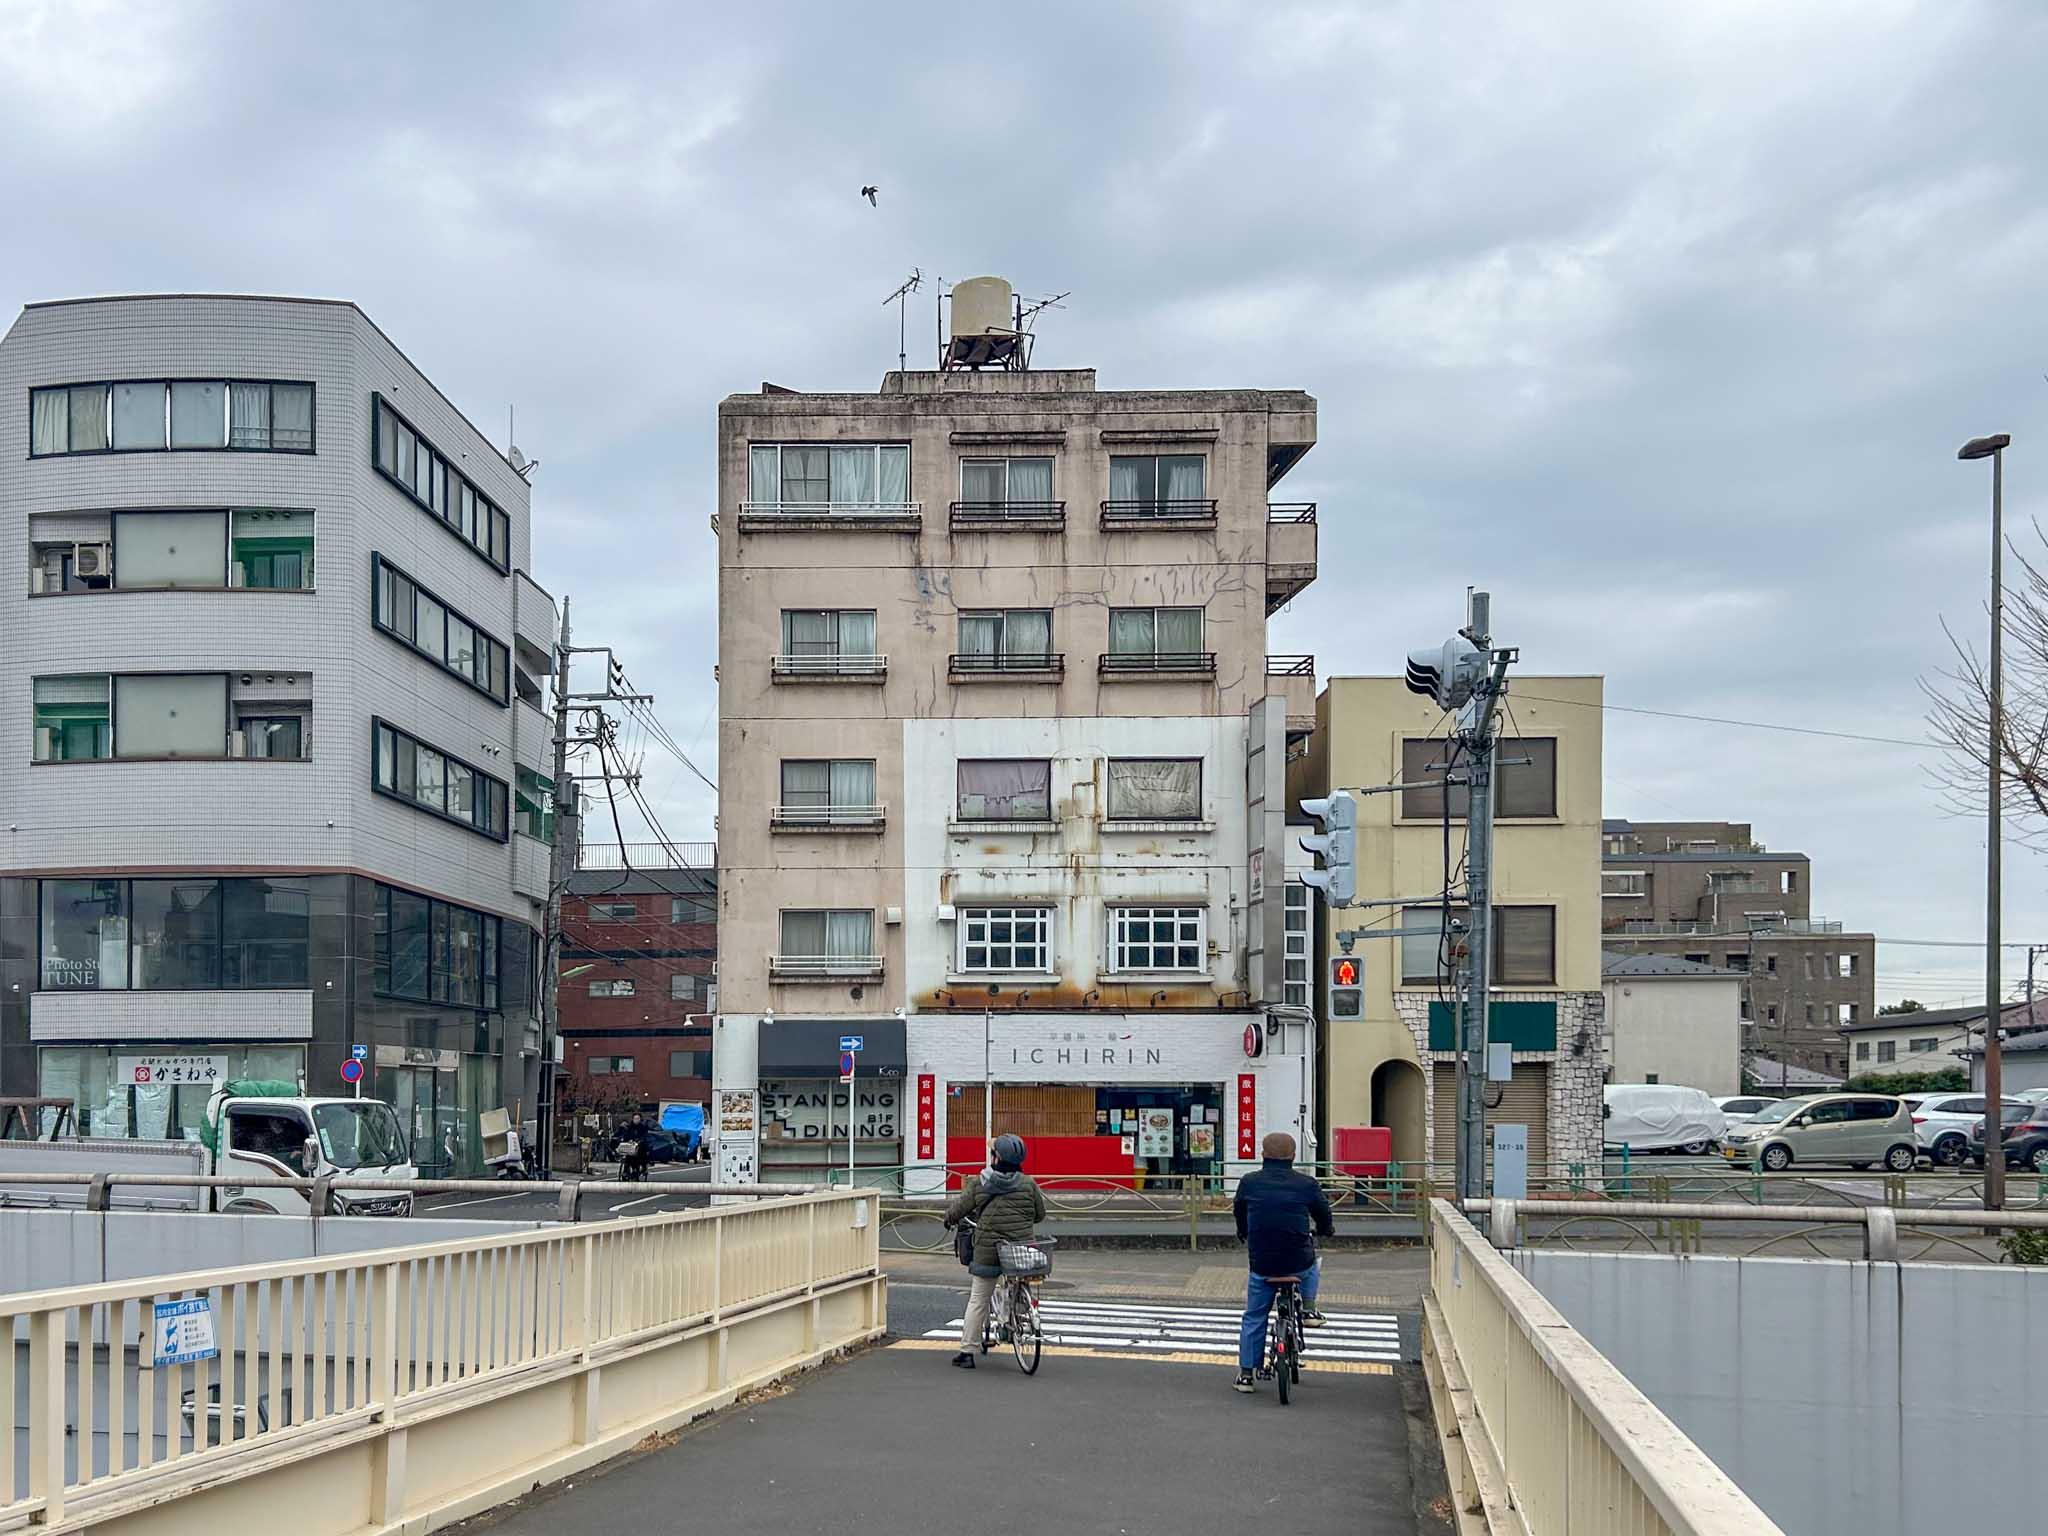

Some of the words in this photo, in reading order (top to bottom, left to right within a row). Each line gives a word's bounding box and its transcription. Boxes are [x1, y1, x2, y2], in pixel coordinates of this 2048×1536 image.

[46, 958, 82, 970] Photo
[46, 971, 95, 985] TUNE
[1012, 1048, 1161, 1065] ICHIRIN
[155, 1066, 217, 1081] かさねや
[867, 1113, 894, 1123] B1F
